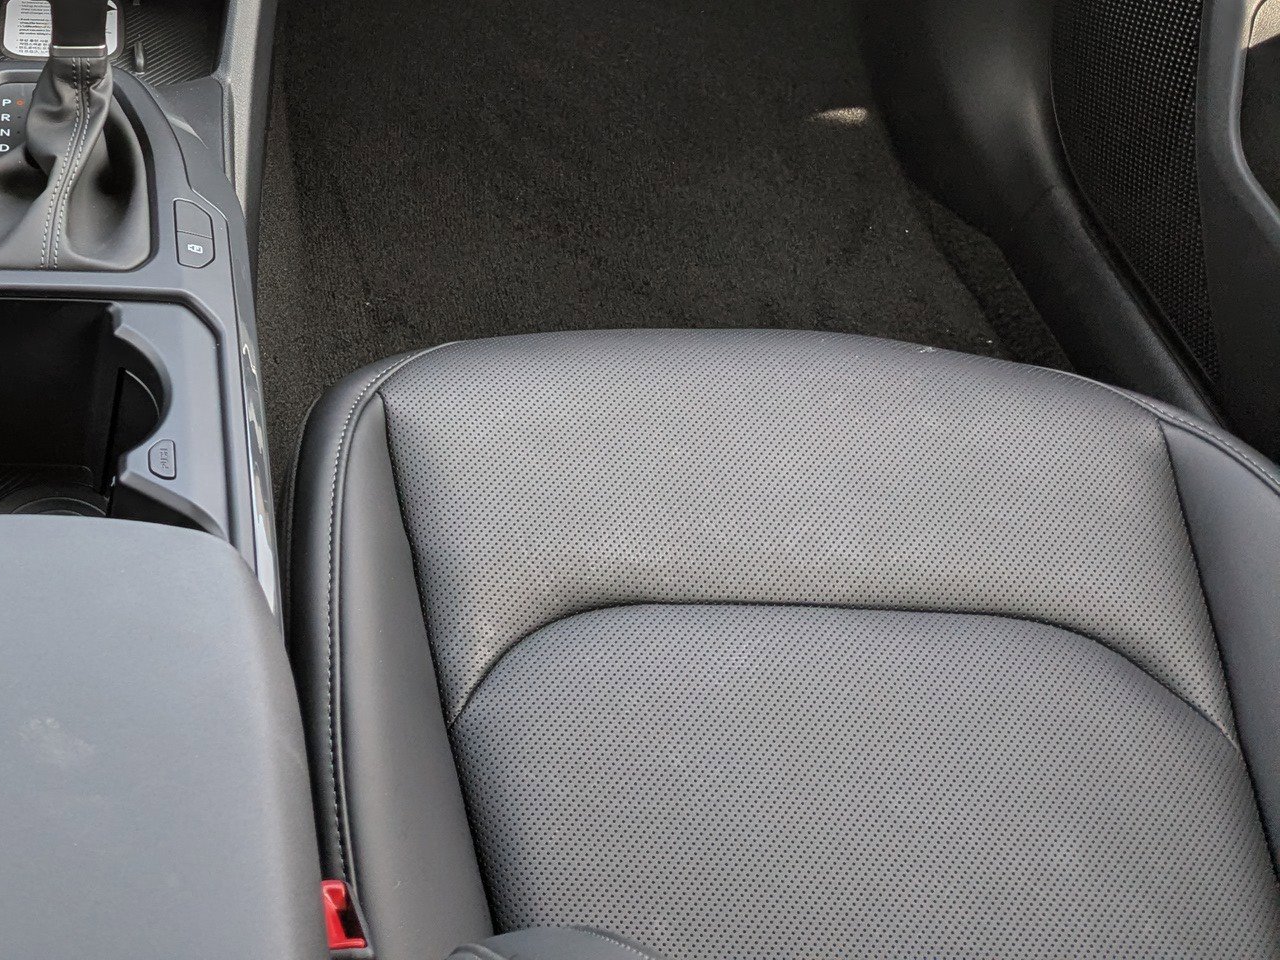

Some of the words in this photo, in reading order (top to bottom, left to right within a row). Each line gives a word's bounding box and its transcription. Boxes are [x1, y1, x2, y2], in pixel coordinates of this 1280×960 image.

[1, 114, 10, 122] R
[0, 128, 10, 137] N
[0, 144, 10, 152] D
